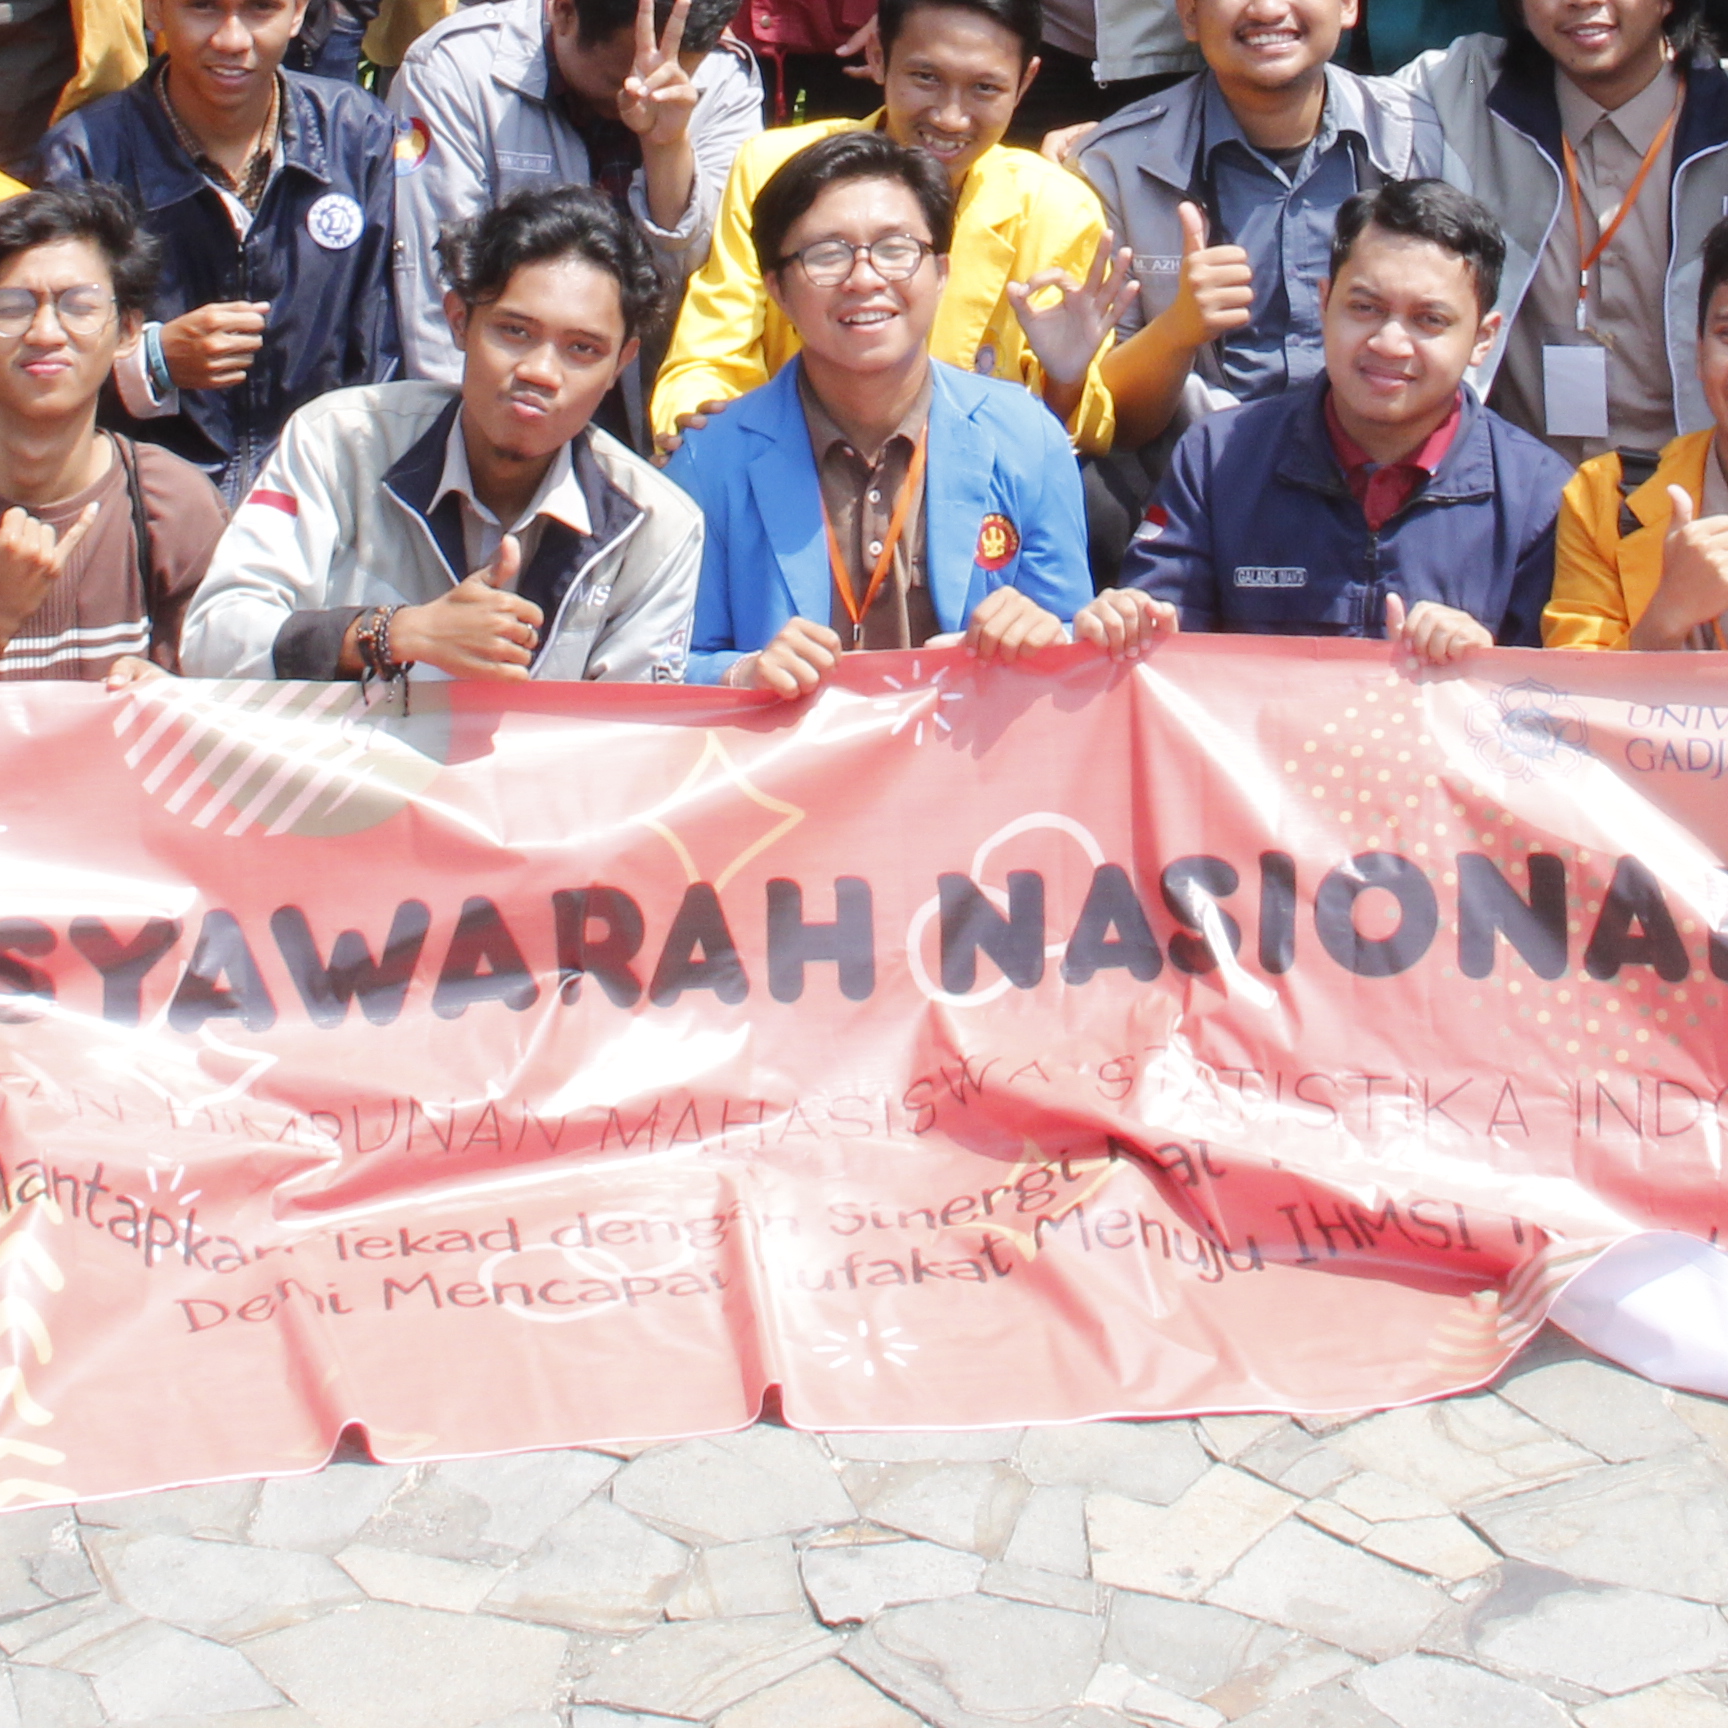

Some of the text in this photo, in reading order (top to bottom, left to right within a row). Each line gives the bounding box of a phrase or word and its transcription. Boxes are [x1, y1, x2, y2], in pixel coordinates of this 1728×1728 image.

[598, 1052, 1052, 1154] MAHASISWA
[775, 1230, 1014, 1296] ufakat
[1276, 1196, 1482, 1266] IHMSI
